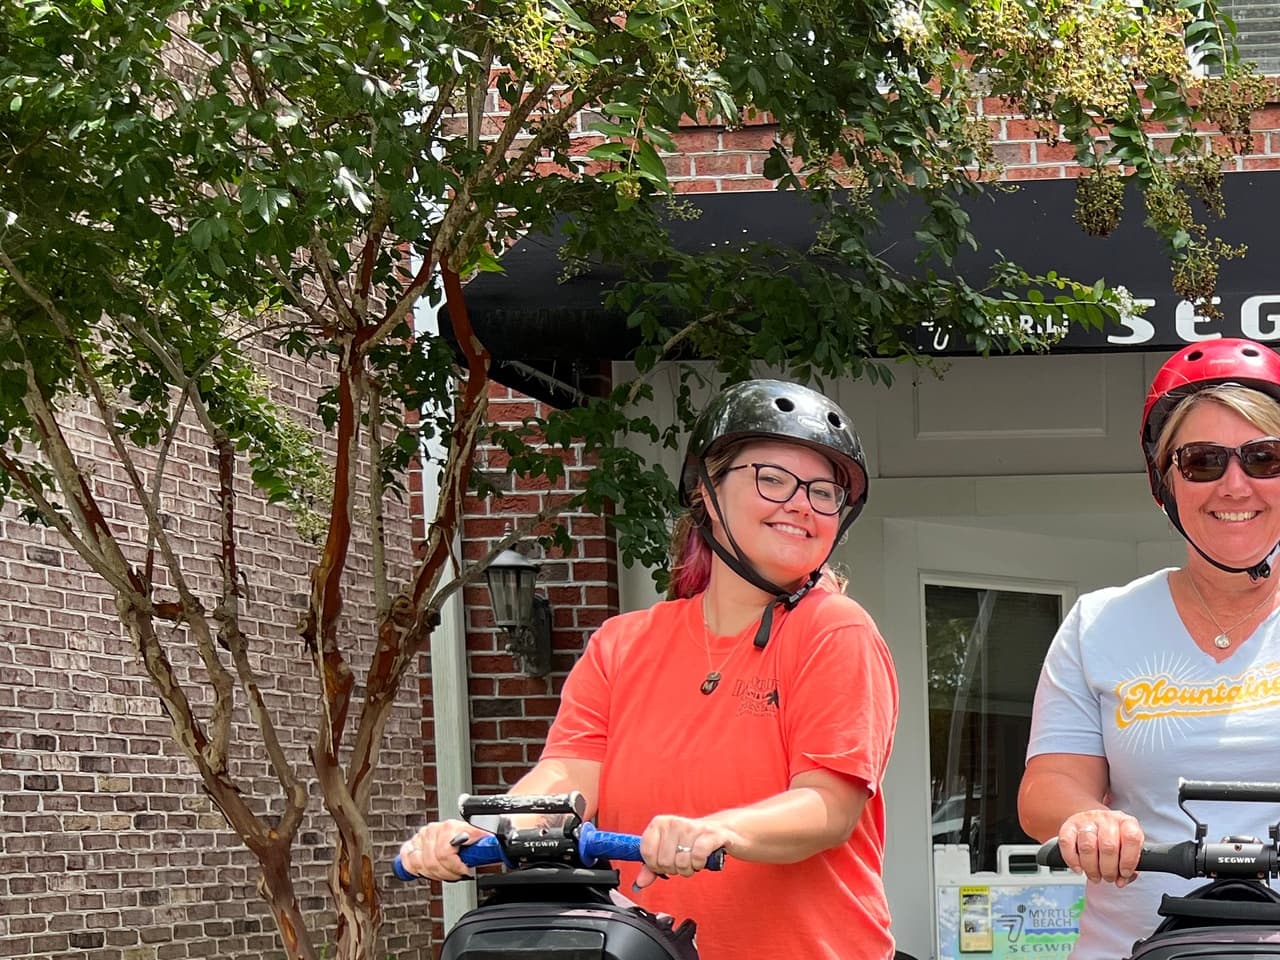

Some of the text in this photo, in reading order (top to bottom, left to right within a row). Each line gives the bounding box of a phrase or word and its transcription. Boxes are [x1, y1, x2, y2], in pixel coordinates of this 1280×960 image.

[523, 840, 560, 848] SEGWAY
[1217, 856, 1257, 864] SEGWAY
[1029, 908, 1075, 918] MYRTLE
[1033, 918, 1072, 928] BEACH
